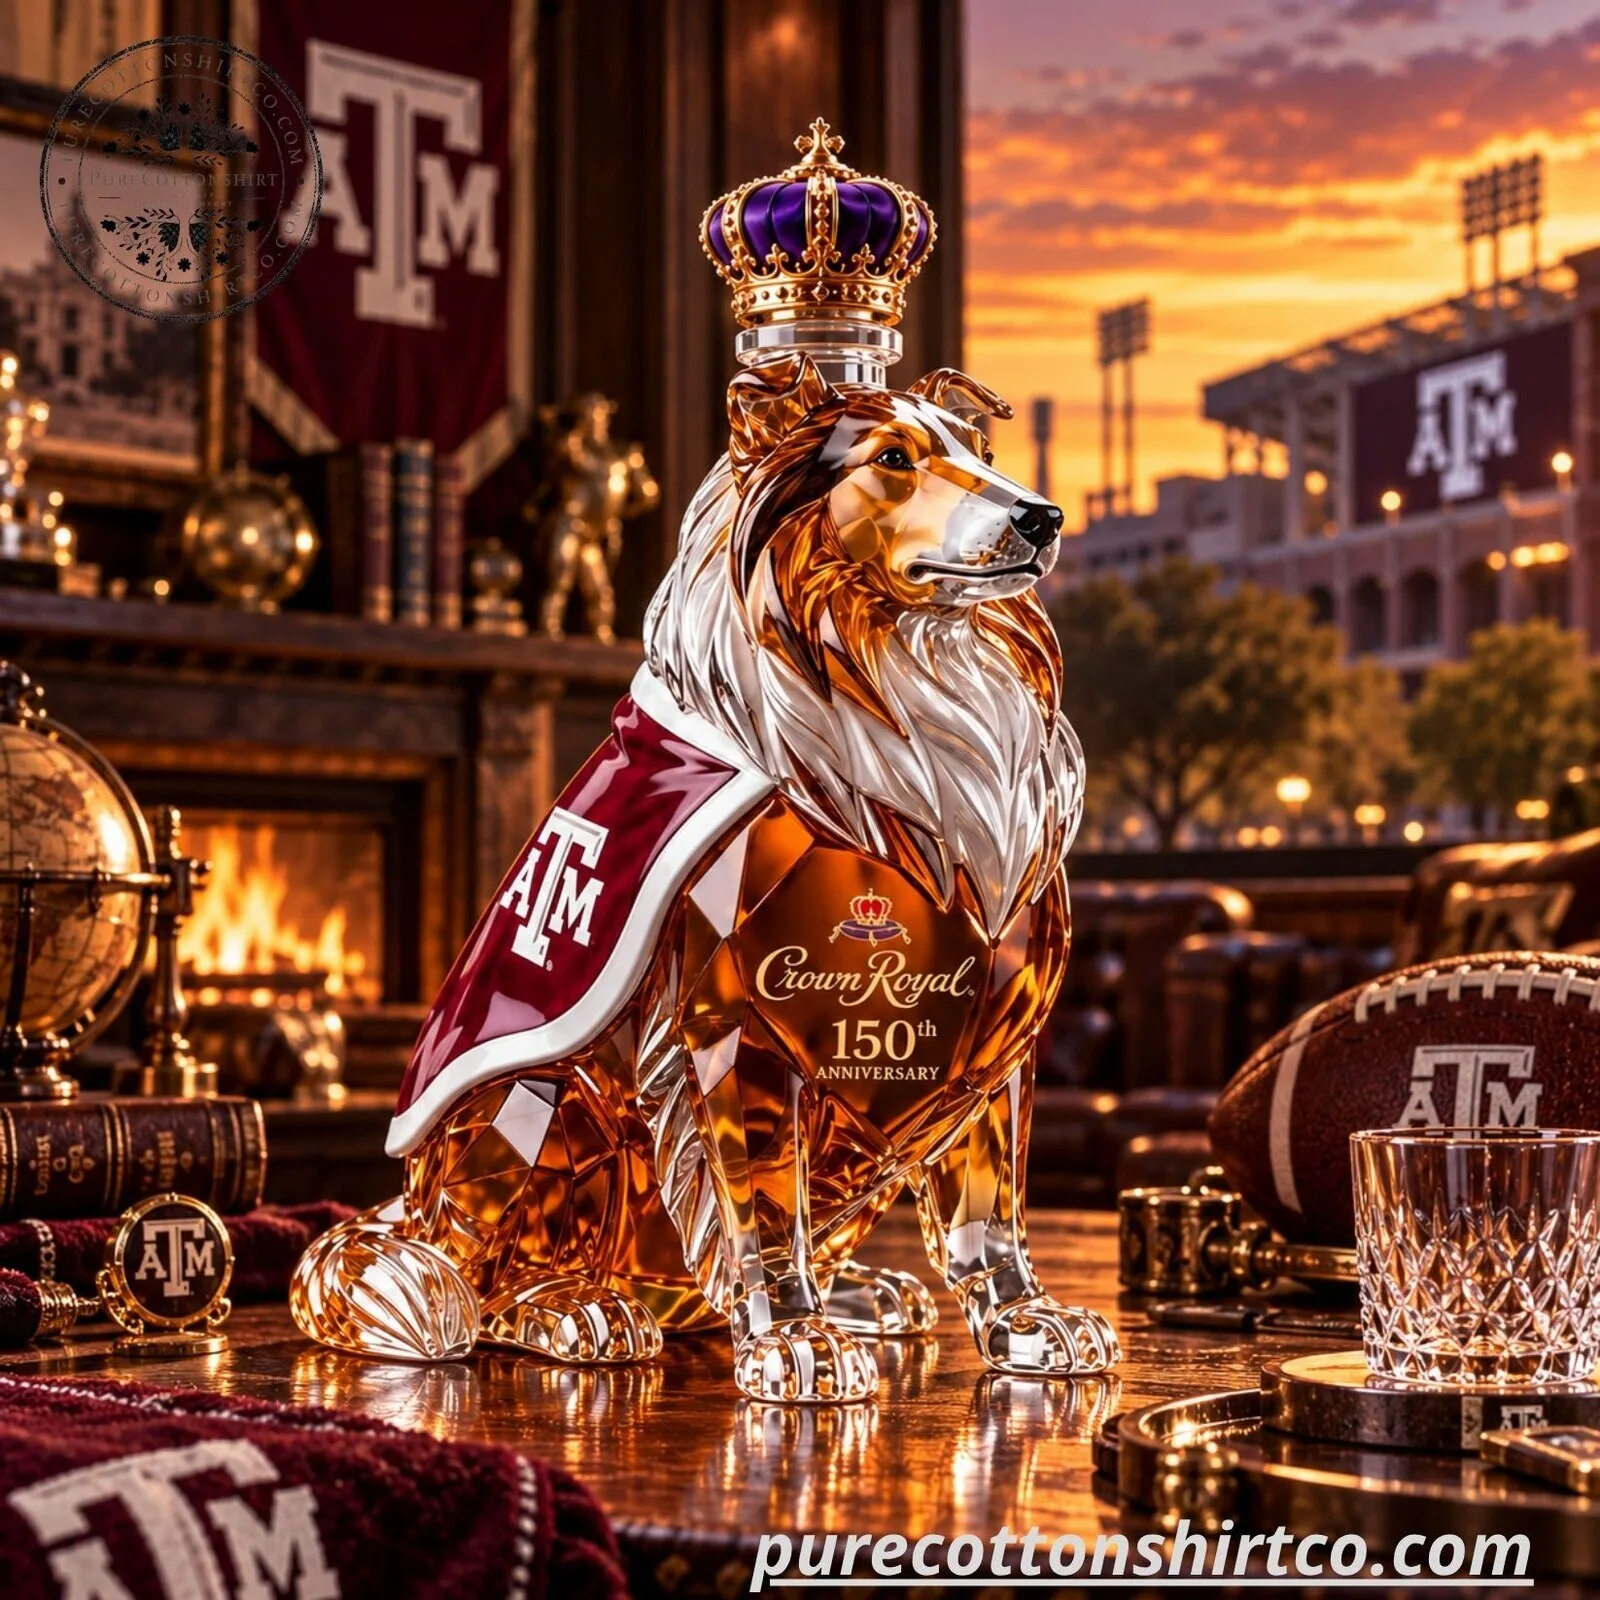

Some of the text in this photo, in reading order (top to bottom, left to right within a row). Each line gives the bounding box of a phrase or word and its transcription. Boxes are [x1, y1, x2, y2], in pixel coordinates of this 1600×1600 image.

[756, 946, 975, 1009] Crown Royal
[831, 1018, 938, 1062] 150th
[815, 1066, 941, 1081] ANNIVERSARY
